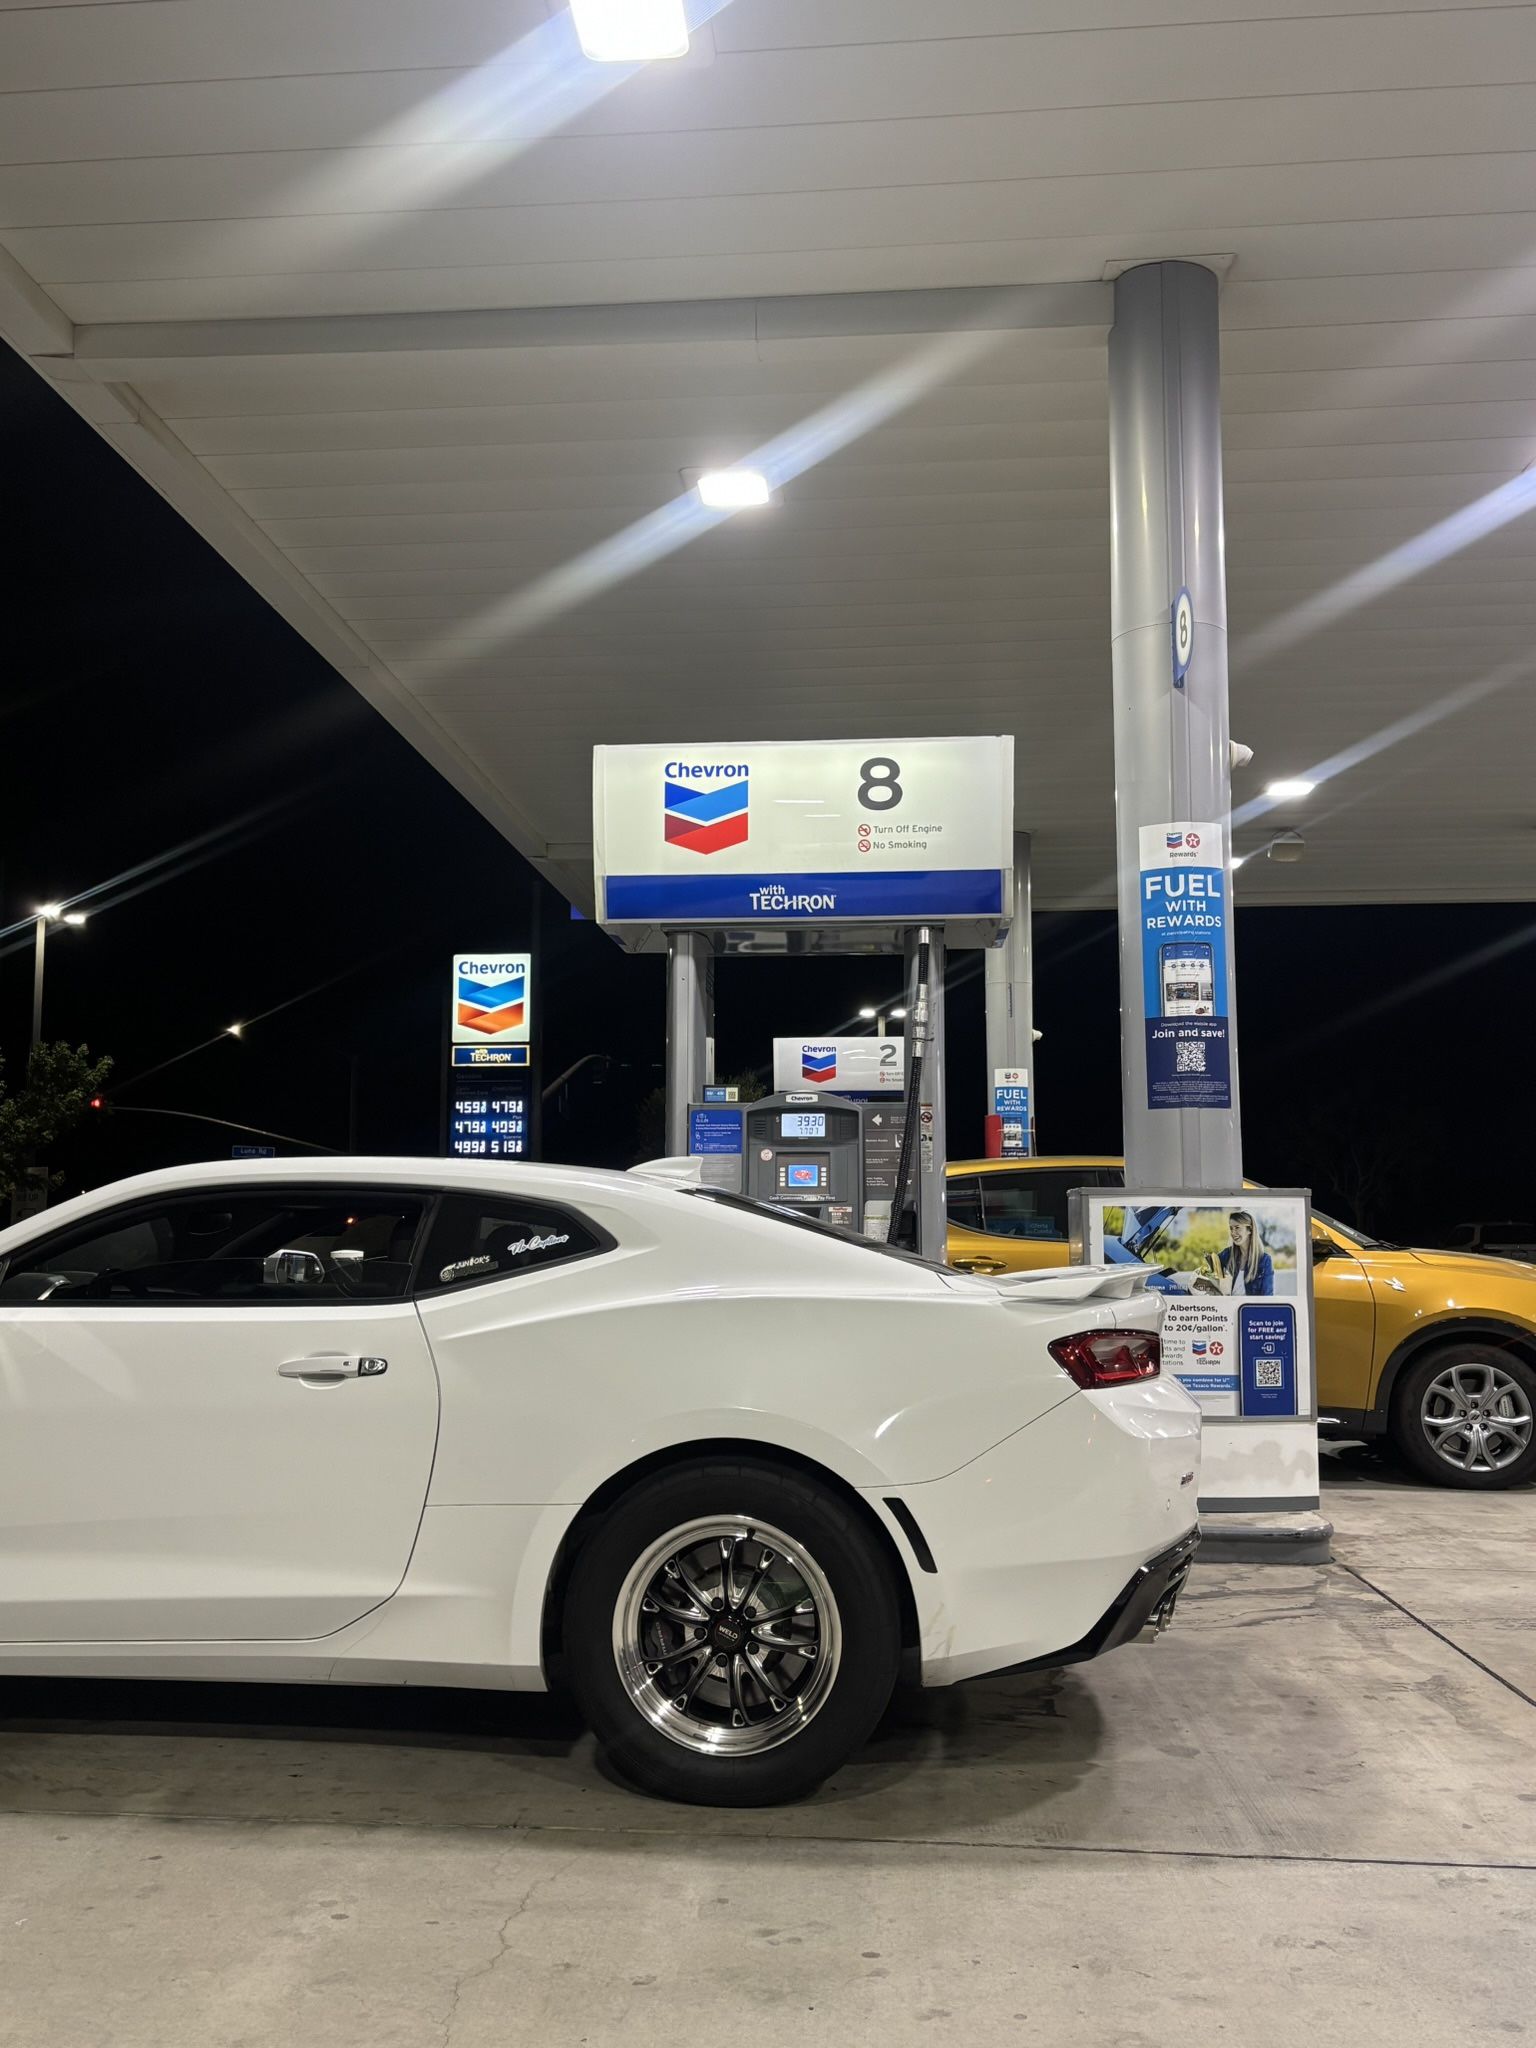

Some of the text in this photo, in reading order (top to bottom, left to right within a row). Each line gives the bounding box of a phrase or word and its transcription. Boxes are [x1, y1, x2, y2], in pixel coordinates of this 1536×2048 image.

[1180, 610, 1188, 648] 8
[664, 761, 749, 779] Chevron
[857, 757, 903, 811] 8
[873, 824, 943, 834] Turn Off Engine
[873, 840, 927, 850] No Smoking
[759, 885, 785, 895] with
[1145, 874, 1220, 899] FUEL
[749, 893, 835, 913] TECHRON
[1165, 900, 1206, 912] WITH
[1146, 915, 1222, 929] REWARDS
[458, 961, 525, 974] Chevron
[1152, 1028, 1225, 1039] Join and save!
[470, 1053, 512, 1063] TECHRON
[880, 1044, 897, 1066] 2
[996, 1089, 1027, 1100] FUEL
[1170, 1304, 1218, 1312] Albertsons,
[719, 1625, 738, 1639] WELD
